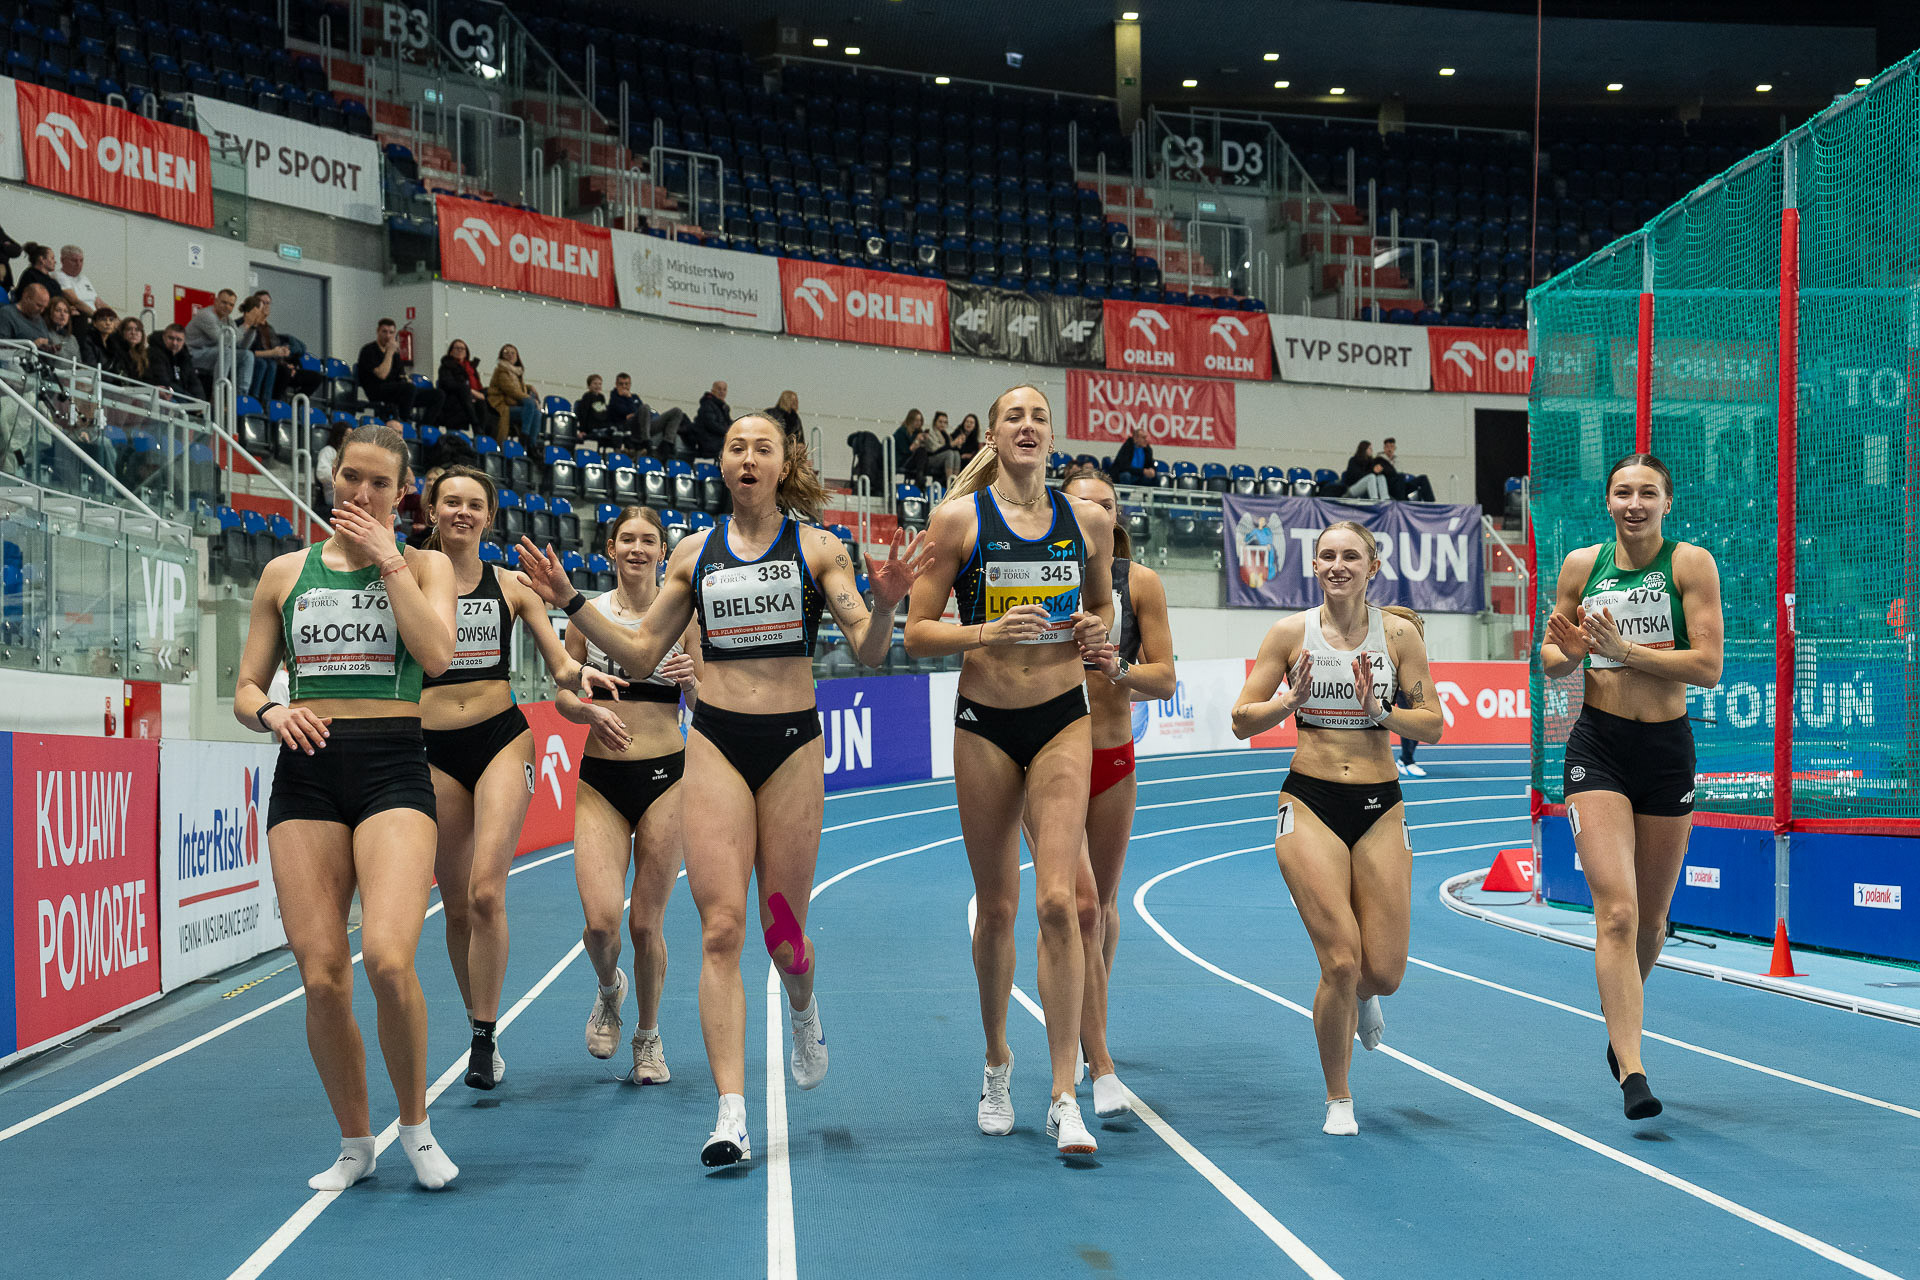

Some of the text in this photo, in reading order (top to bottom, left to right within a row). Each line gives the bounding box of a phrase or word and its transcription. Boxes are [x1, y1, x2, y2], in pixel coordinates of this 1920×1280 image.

[383, 2, 429, 49] B3
[449, 19, 495, 62] C3
[215, 130, 362, 191] TVP SPORT
[1162, 135, 1205, 169] C3
[1221, 140, 1264, 175] D3
[98, 136, 197, 194] ORLEN
[509, 233, 599, 279] ORLEN
[666, 258, 735, 281] Ministerstwo
[667, 276, 701, 294] Sportu
[709, 282, 758, 302] Turystyki
[846, 290, 935, 326] ORLEN
[955, 307, 988, 331] 4F
[1007, 314, 1039, 338] 4F
[1060, 320, 1096, 343] 4F
[1123, 348, 1175, 367] ORLEN
[1204, 355, 1254, 373] ORLEN
[1285, 337, 1412, 367] TVP SPORT
[1088, 378, 1195, 410] KUJAWY
[1088, 408, 1215, 441] POMORZE
[986, 541, 1011, 551] esa
[1047, 541, 1077, 561] Sopot
[1290, 517, 1469, 583] TRUŃ
[757, 564, 792, 582] 338
[1002, 570, 1030, 580] TORUŃ
[1040, 565, 1073, 582] 345
[1595, 578, 1620, 591] 4F
[141, 556, 187, 641] VIP
[352, 594, 389, 610] 176
[463, 602, 493, 616] 274
[712, 592, 796, 619] BIELSKA
[1628, 590, 1662, 605] 470
[300, 623, 388, 644] SŁOCKA
[457, 626, 498, 642] OWSKA
[1040, 633, 1058, 641] 2025
[1616, 615, 1670, 636] VYTSKA
[732, 632, 783, 644] TORUŃ 2025
[318, 663, 371, 671] TORUŃ 2025
[450, 658, 465, 666] RUŃ
[1316, 657, 1342, 667] TORUŃ
[820, 691, 873, 775] UŃ
[1321, 717, 1370, 726] TORUŃ 2025
[526, 764, 533, 790] 3
[37, 770, 133, 869] KUJAWY
[1278, 805, 1289, 834] 7
[178, 807, 244, 880] InterRisk
[1865, 887, 1892, 905] polanik
[37, 879, 149, 999] POMORZE
[178, 920, 203, 955] VIENNA
[202, 908, 242, 946] INSURANCE
[241, 903, 260, 933] GROUP
